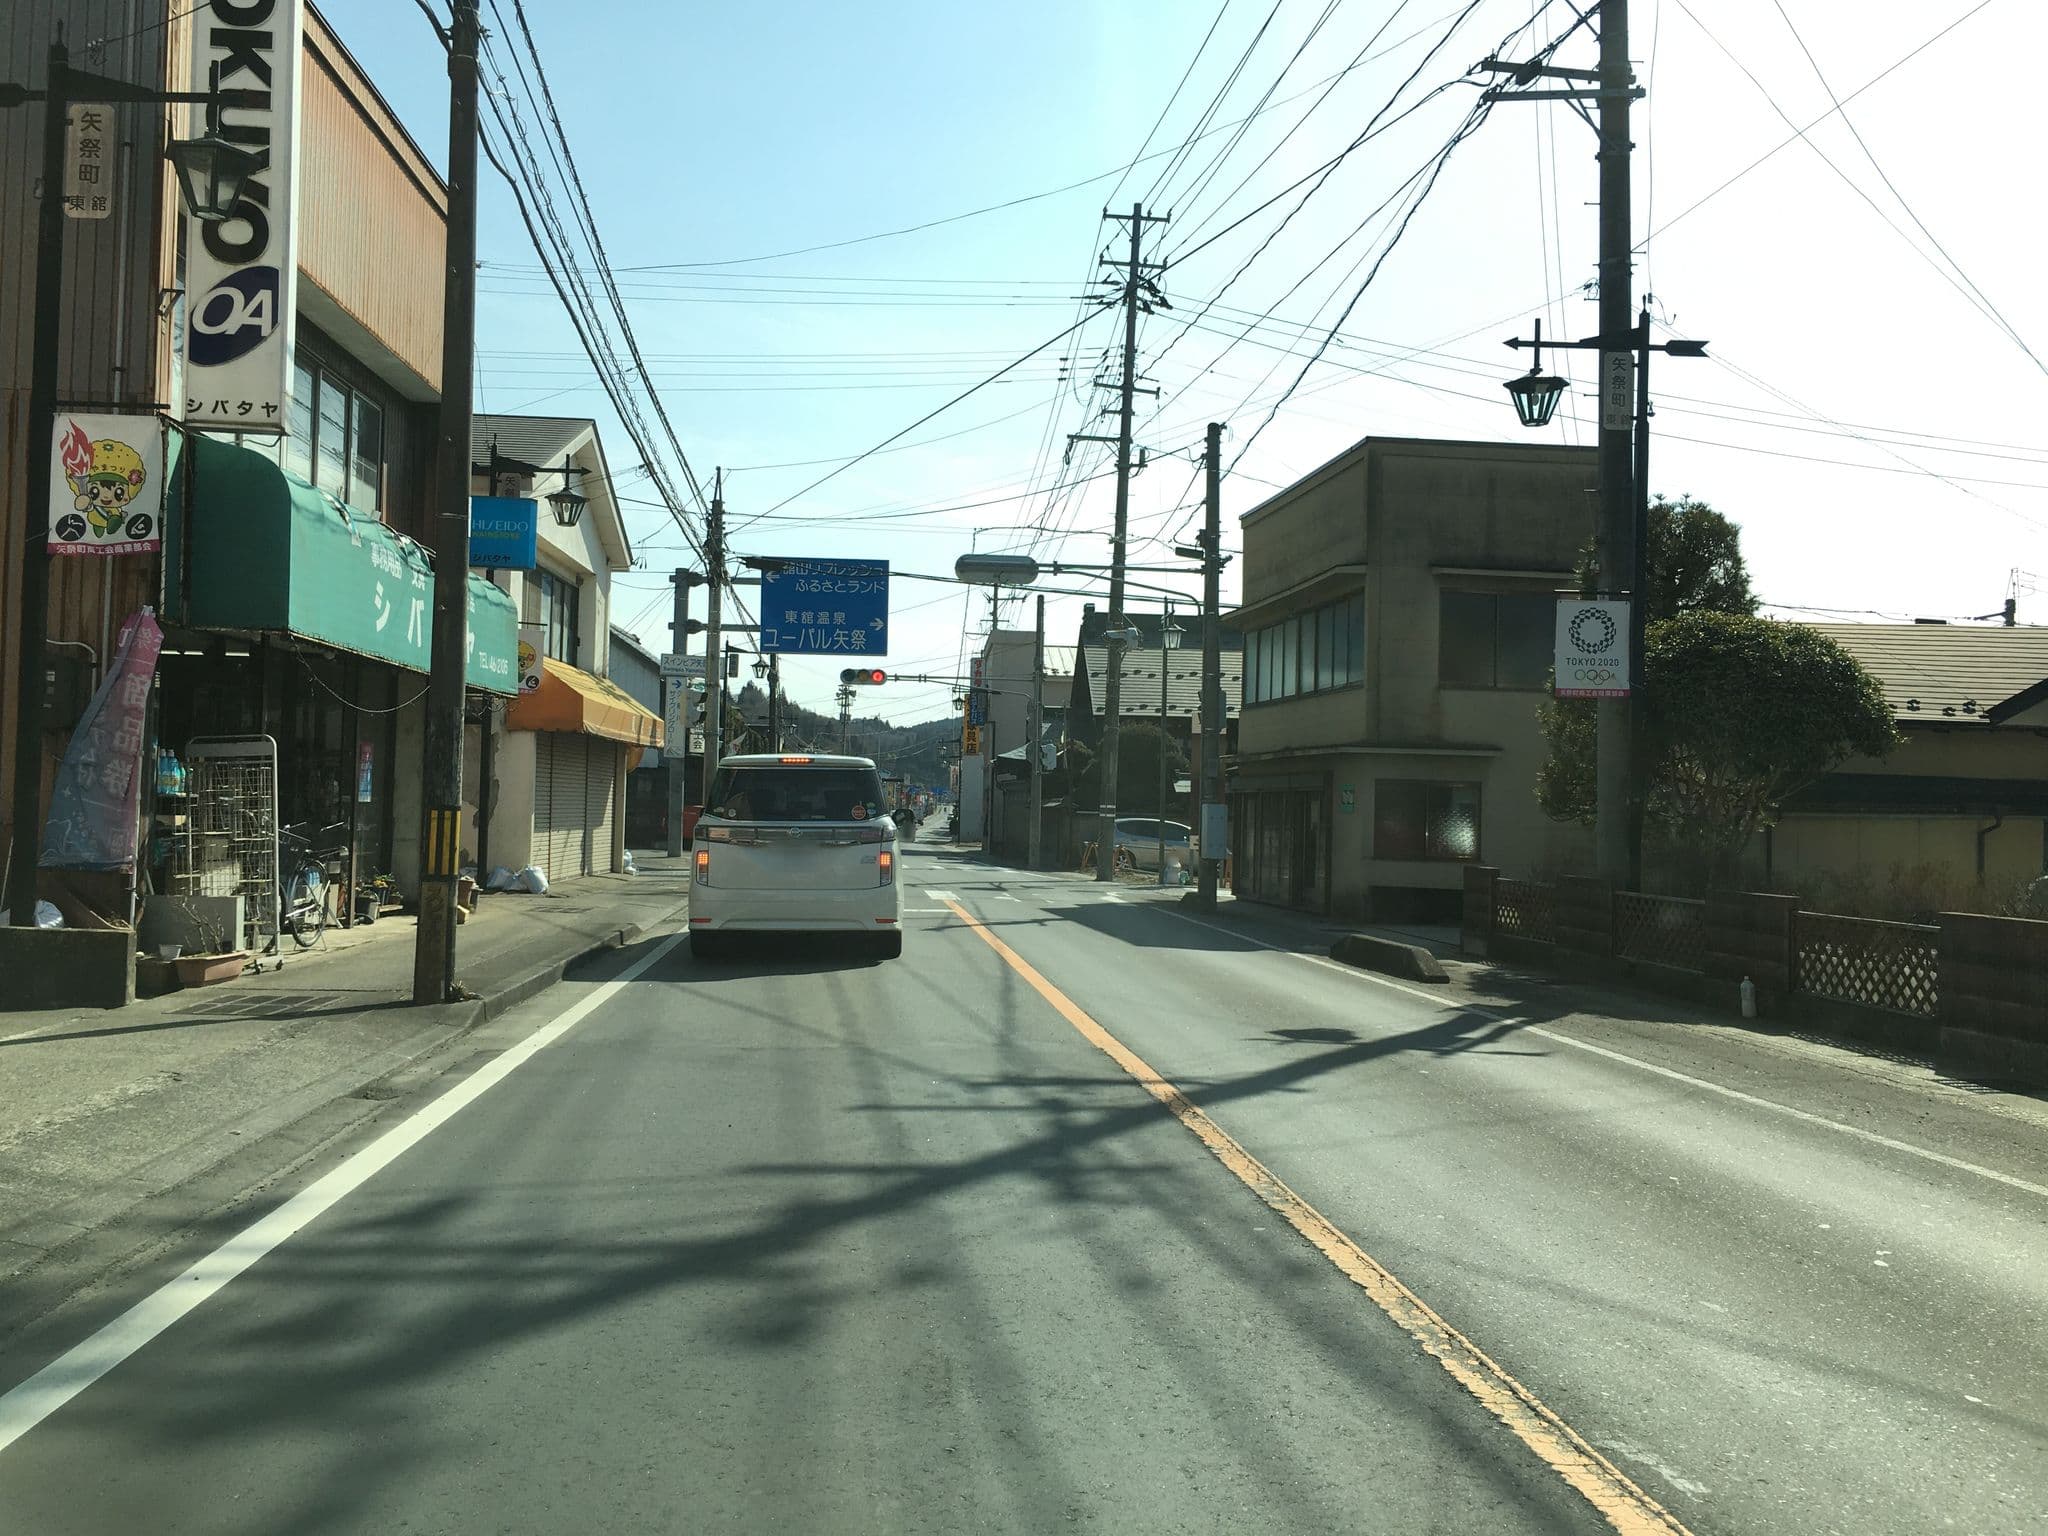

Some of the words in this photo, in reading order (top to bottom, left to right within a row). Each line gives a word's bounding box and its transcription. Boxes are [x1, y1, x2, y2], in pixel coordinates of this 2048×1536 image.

[79, 111, 102, 184] 矢祭町
[190, 285, 274, 338] OA
[186, 398, 279, 418] シバタヤ
[91, 463, 126, 474] やまつり
[472, 519, 529, 533] HISEIDO
[795, 578, 886, 595] ふるさとランド
[784, 609, 847, 626] 東舘温泉
[1566, 657, 1596, 667] TOKYO
[1598, 658, 1620, 667] 2020
